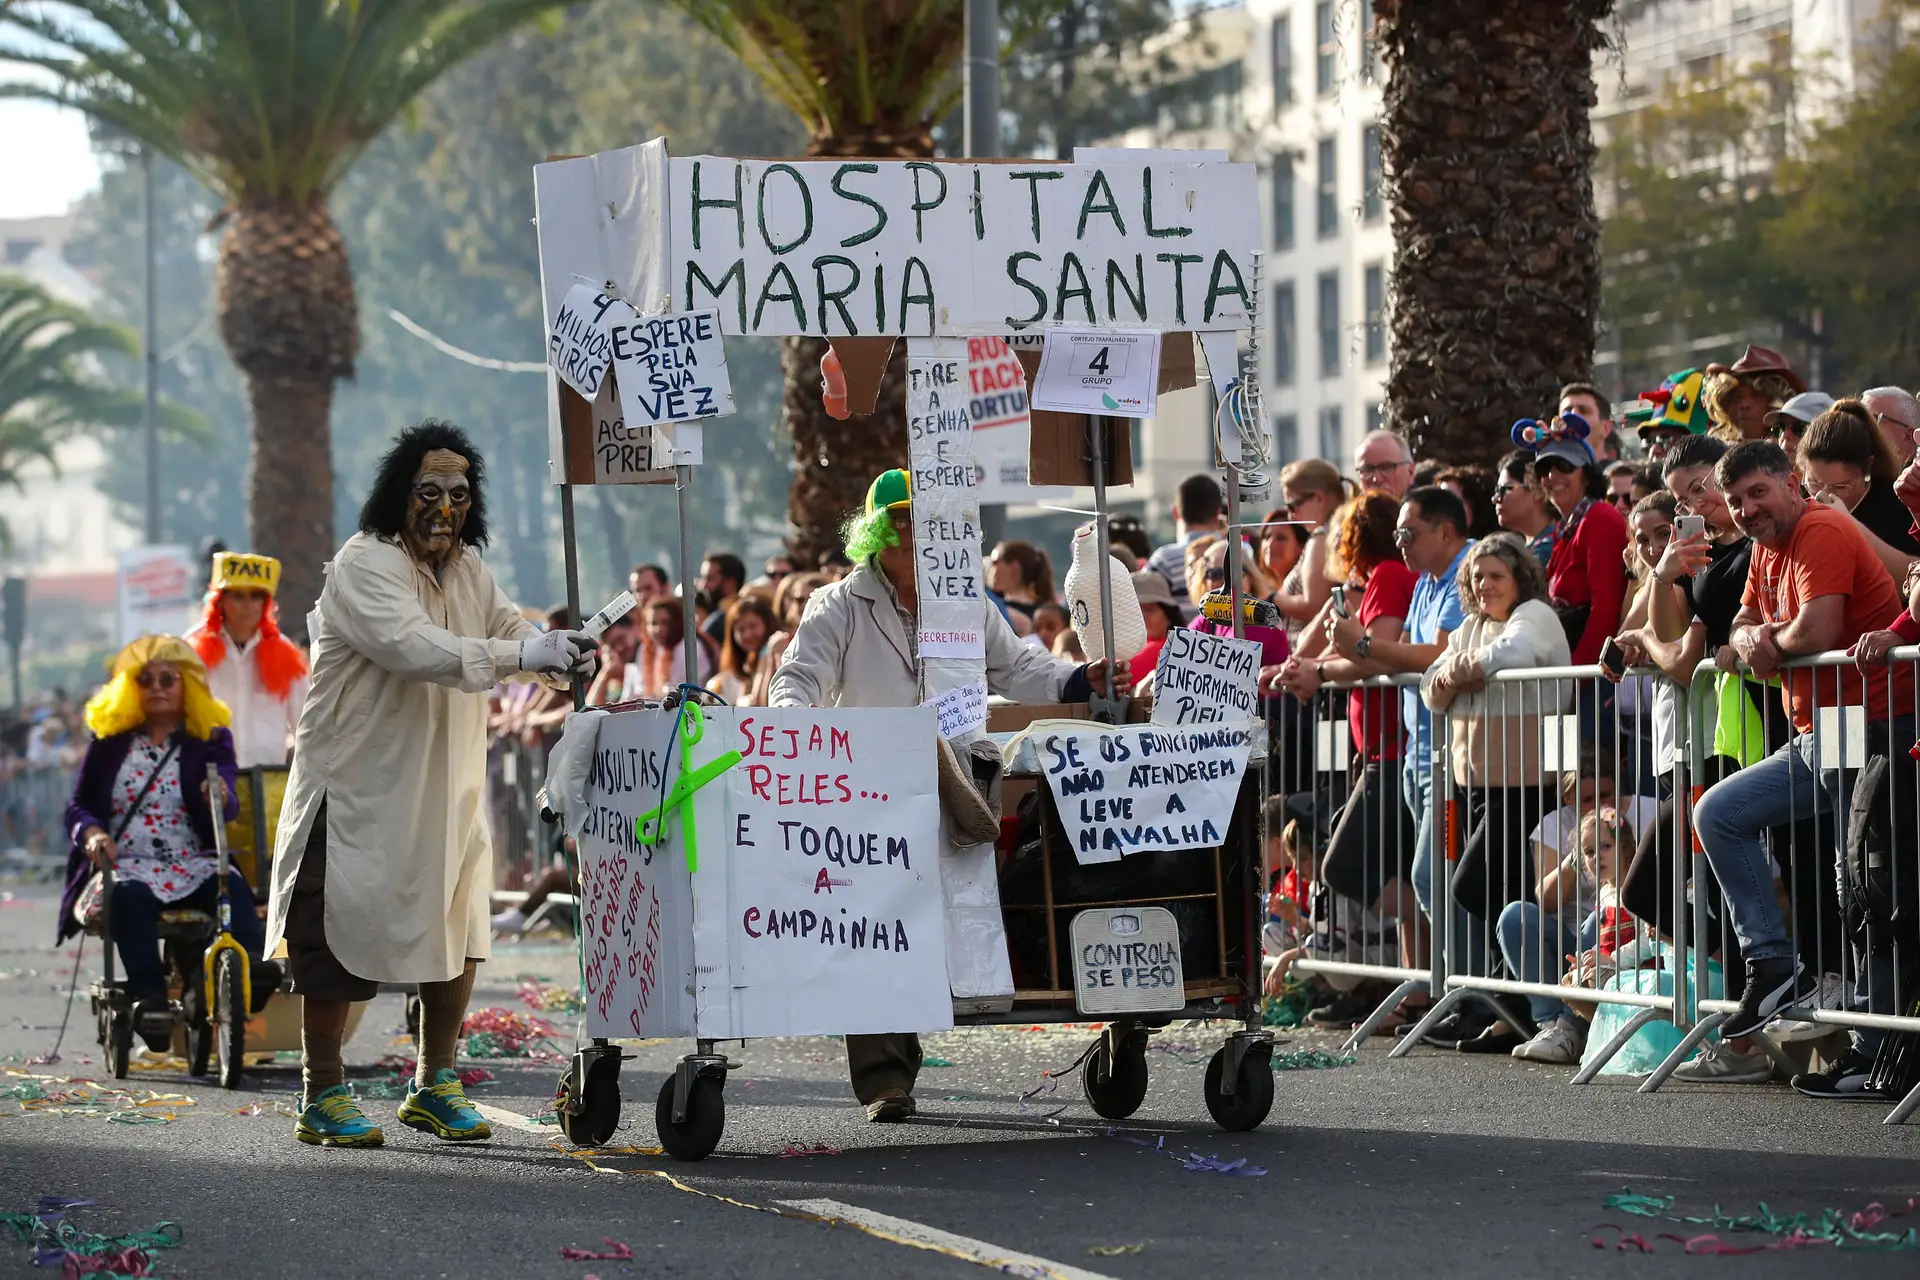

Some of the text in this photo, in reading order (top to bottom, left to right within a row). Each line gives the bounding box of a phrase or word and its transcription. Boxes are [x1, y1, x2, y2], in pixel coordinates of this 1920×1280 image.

[691, 160, 1193, 255] HOSPITAL
[685, 248, 1253, 336] MARIA SANTA
[611, 314, 713, 360] ESPERE
[637, 348, 698, 373] PELA
[1088, 346, 1109, 375] 4
[648, 369, 695, 393] SUA
[909, 361, 959, 390] TIRE
[1081, 377, 1113, 385] GRUPO
[638, 387, 716, 420] VEZ
[928, 391, 941, 412] A
[911, 408, 970, 440] SENHA
[937, 440, 950, 463] E
[915, 465, 976, 491] ESPERE
[922, 520, 976, 542] PELA
[229, 560, 272, 580] TAXI
[922, 547, 971, 571] SUA
[928, 575, 978, 598] VEZ
[918, 630, 977, 643] SECRETÁRIA
[1171, 628, 1253, 677] SISTEMA
[1163, 665, 1250, 711] INFORMATICO
[965, 699, 982, 714] que
[739, 717, 853, 763] SEJAM
[1046, 727, 1251, 775] SE OS FUNCIONARIOS
[589, 746, 660, 796] ONSULTAS
[747, 764, 889, 806] RELES...
[1061, 758, 1236, 797] NÃO ATENDEREM
[1080, 792, 1187, 823] LEVE A
[736, 813, 911, 870] E TOQUEM
[1079, 819, 1221, 852] NAVALHA
[813, 867, 833, 894] A
[743, 906, 910, 953] CAMPAINHA
[1083, 941, 1179, 967] CONTROLA
[1085, 965, 1176, 989] SE PESO
